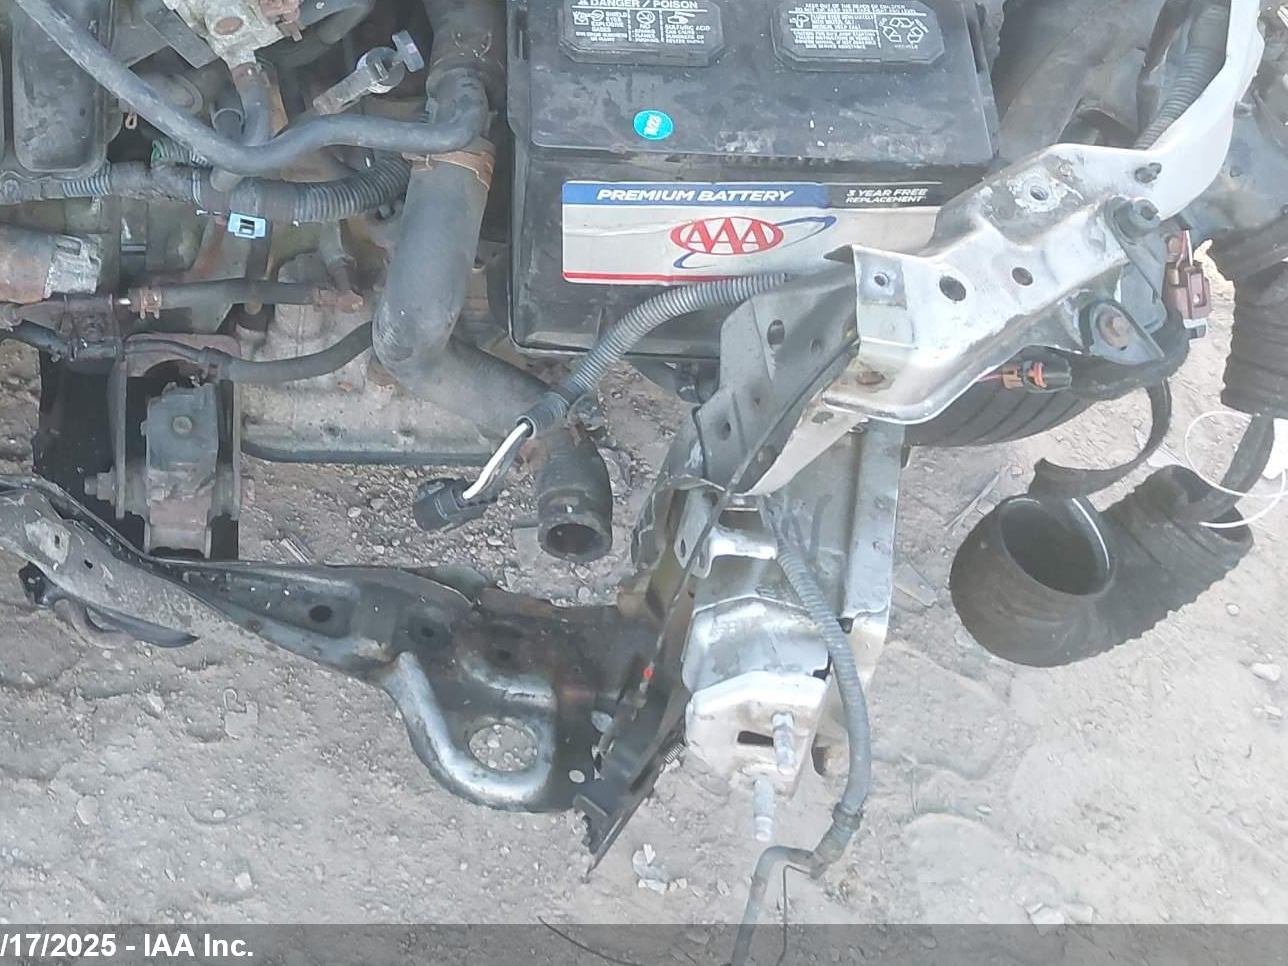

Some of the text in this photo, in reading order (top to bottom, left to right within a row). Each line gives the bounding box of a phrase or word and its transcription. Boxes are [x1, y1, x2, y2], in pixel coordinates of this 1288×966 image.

[641, 0, 651, 8] /
[653, 0, 698, 9] POISON
[597, 189, 794, 202] PREMIUM BATTERY
[846, 188, 929, 197] 3 YEAR FREE
[684, 217, 771, 255] AAA
